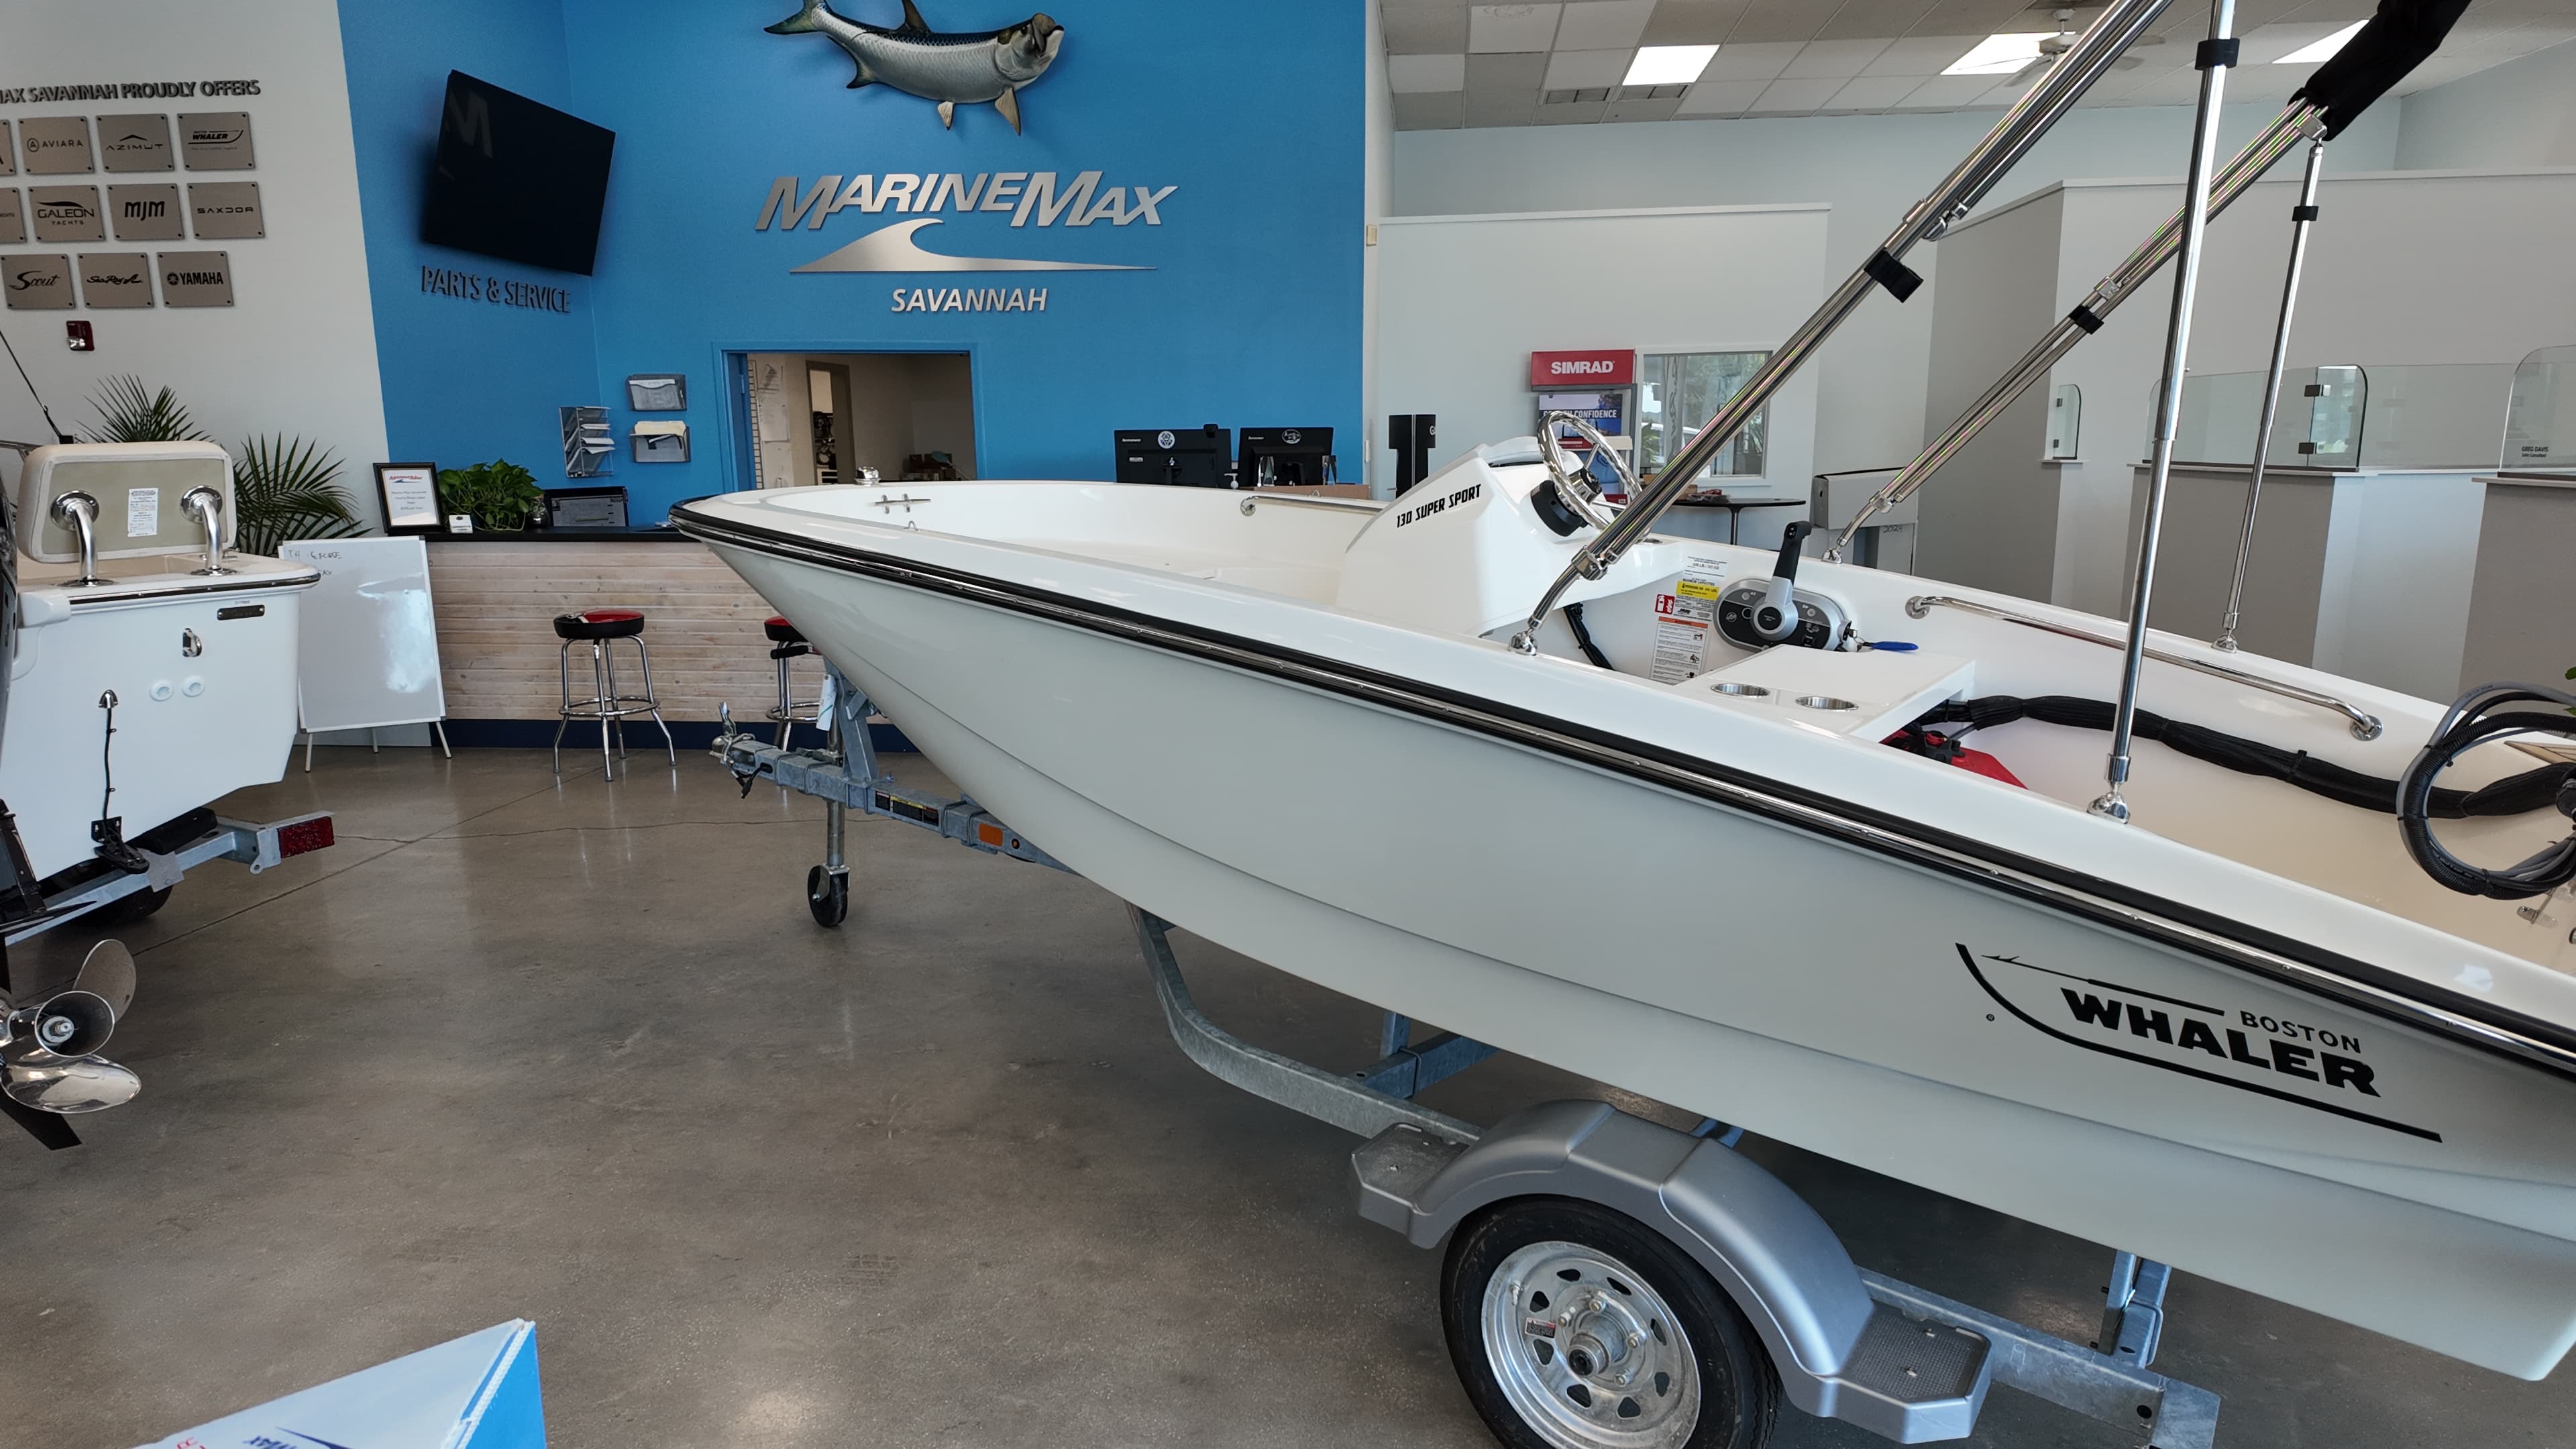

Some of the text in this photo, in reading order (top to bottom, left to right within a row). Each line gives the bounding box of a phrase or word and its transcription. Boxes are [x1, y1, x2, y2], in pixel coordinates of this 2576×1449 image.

[0, 79, 261, 104] AX SAVANNAH PROUDLY OFFERS
[42, 140, 84, 148] AVIARA
[38, 209, 95, 219] GALEON
[9, 270, 61, 290] Scout
[179, 272, 224, 284] YAMAHA
[421, 266, 572, 313] PARTS & SERVICE
[891, 288, 1049, 312] SAVANNAH
[1550, 360, 1613, 374] SIMRAD
[1574, 409, 1617, 418] CONFIDENCE
[1397, 484, 1481, 528] 130 SUPER SPORT
[2059, 987, 2381, 1097] WHALER
[2240, 1010, 2362, 1054] BOSTON
